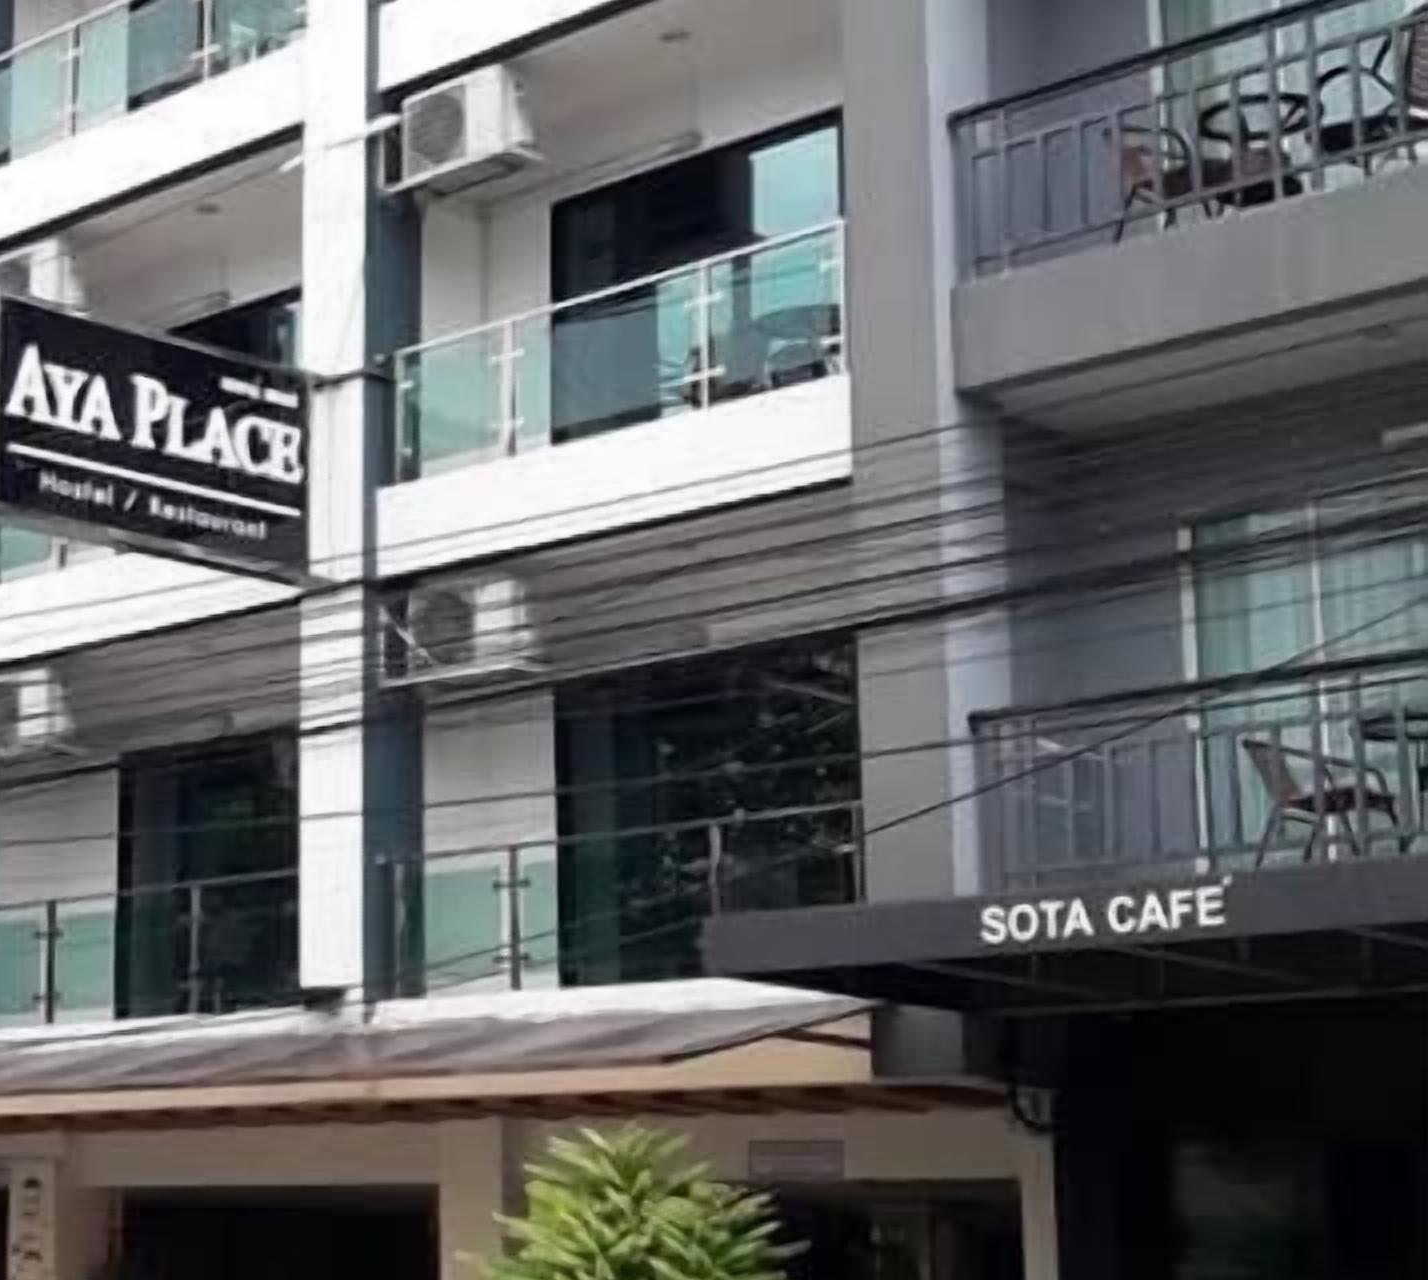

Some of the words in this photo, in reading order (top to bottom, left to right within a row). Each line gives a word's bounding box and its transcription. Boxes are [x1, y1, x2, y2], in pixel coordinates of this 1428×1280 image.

[5, 343, 122, 442] AYA
[129, 372, 304, 486] PLACE
[39, 469, 114, 507] Hostel
[149, 495, 269, 541] Restaurant
[980, 896, 1095, 945] SOTA
